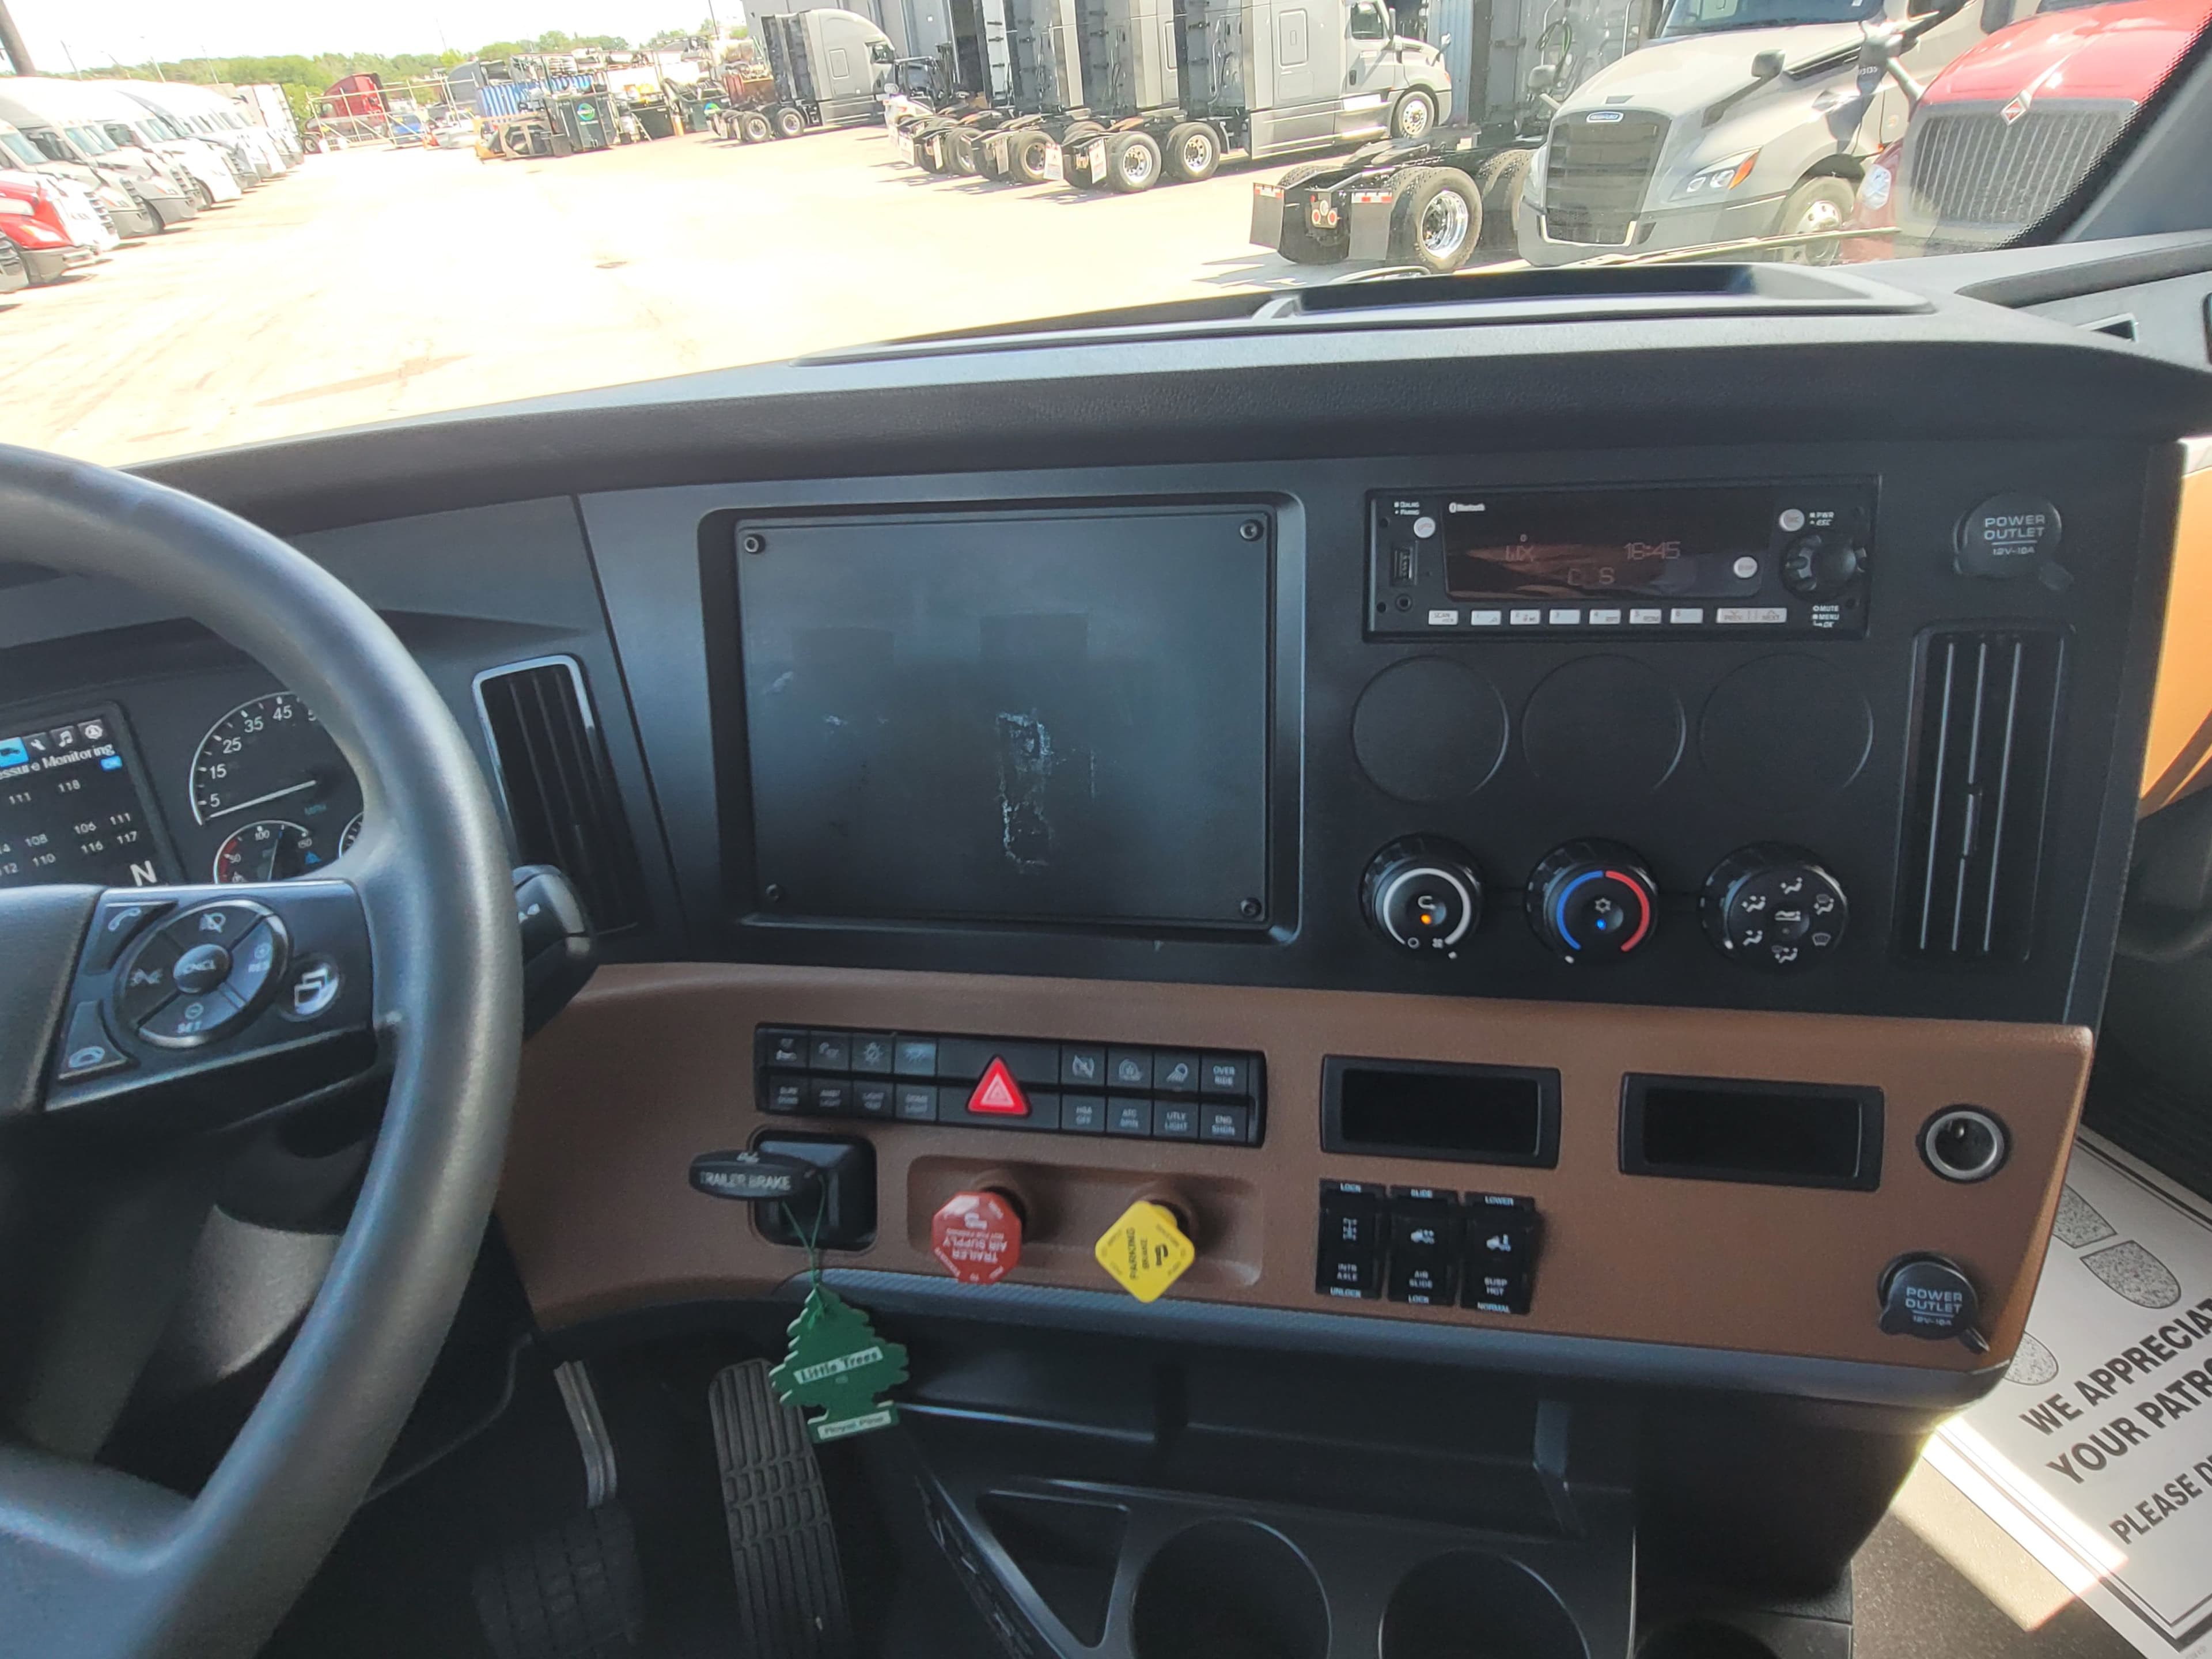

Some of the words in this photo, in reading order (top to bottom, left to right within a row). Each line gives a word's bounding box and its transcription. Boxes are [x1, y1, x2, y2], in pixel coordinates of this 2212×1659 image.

[1985, 514, 2045, 527] POWER
[1984, 527, 2045, 540] OUTLET
[1993, 547, 2035, 555] 12V-10A
[272, 706, 293, 721] 45
[244, 717, 263, 733] 35
[223, 737, 241, 754] 25
[42, 744, 115, 769] Monitoring
[210, 764, 227, 779] 15
[58, 779, 81, 793] 118
[211, 794, 220, 807] 5
[110, 813, 131, 825] 111
[116, 831, 137, 844] 117
[255, 830, 270, 840] 100
[32, 853, 56, 866] 110
[130, 861, 157, 887] N
[1213, 1066, 1236, 1075] OVER
[1215, 1115, 1233, 1124] ENG
[749, 1175, 791, 1191] BRAKE
[1484, 1195, 1513, 1206] LOWER
[942, 1236, 986, 1249] SUPPLY
[952, 1249, 998, 1263] TRAILER
[1127, 1227, 1138, 1279] PARKING
[1414, 1270, 1429, 1279] AIR
[1330, 1287, 1361, 1298] UNLOCK
[1906, 1287, 1962, 1302] POWER
[1408, 1294, 1429, 1305] LOCK
[1905, 1298, 1962, 1313] OUTLET
[1477, 1302, 1510, 1313] NORMAL
[801, 1362, 838, 1381] Little
[841, 1351, 877, 1369] Trees
[2018, 1393, 2084, 1435] WE
[2046, 1417, 2151, 1484] YOUR
[2109, 1473, 2203, 1545] PLEASE
